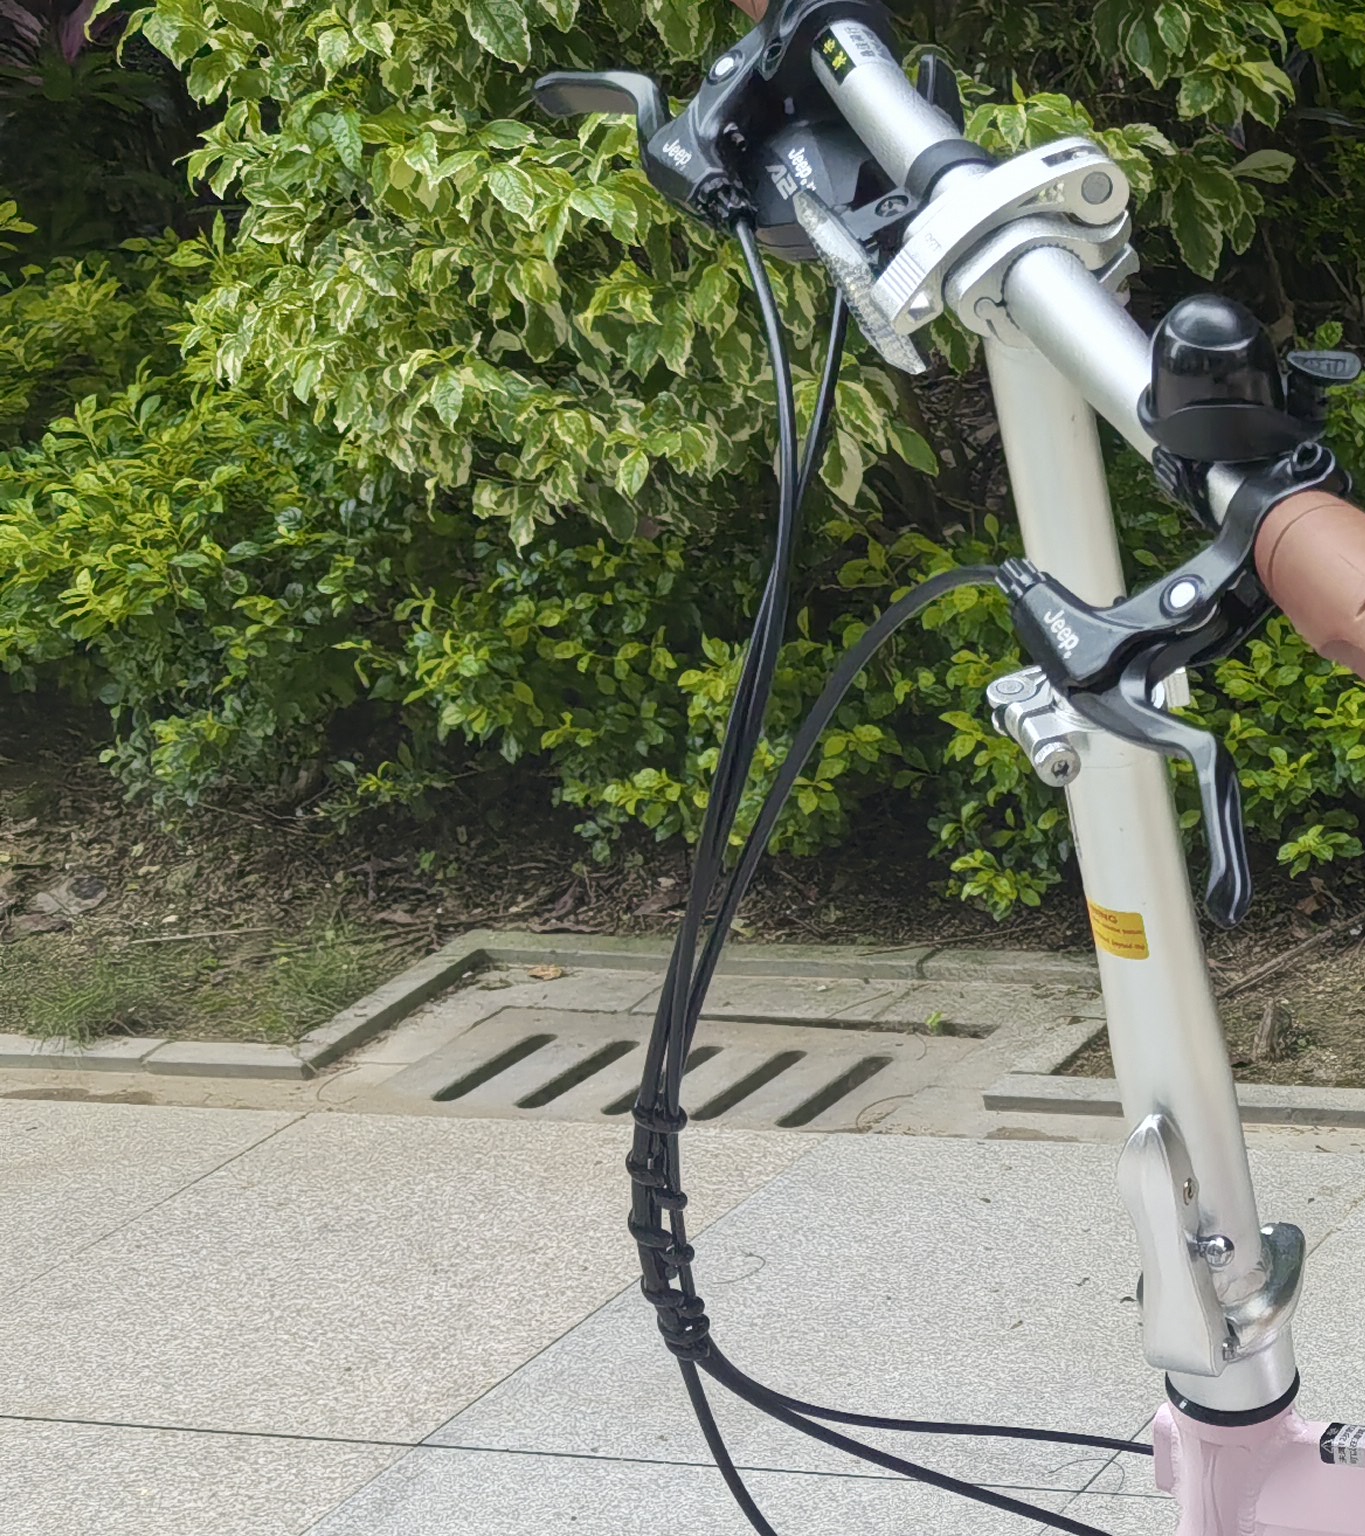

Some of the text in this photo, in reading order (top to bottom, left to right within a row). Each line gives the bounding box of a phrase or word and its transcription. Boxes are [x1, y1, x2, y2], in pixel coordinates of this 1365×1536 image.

[662, 138, 692, 167] Jeep
[787, 147, 813, 179] Jeep
[1043, 609, 1080, 651] Jeep
